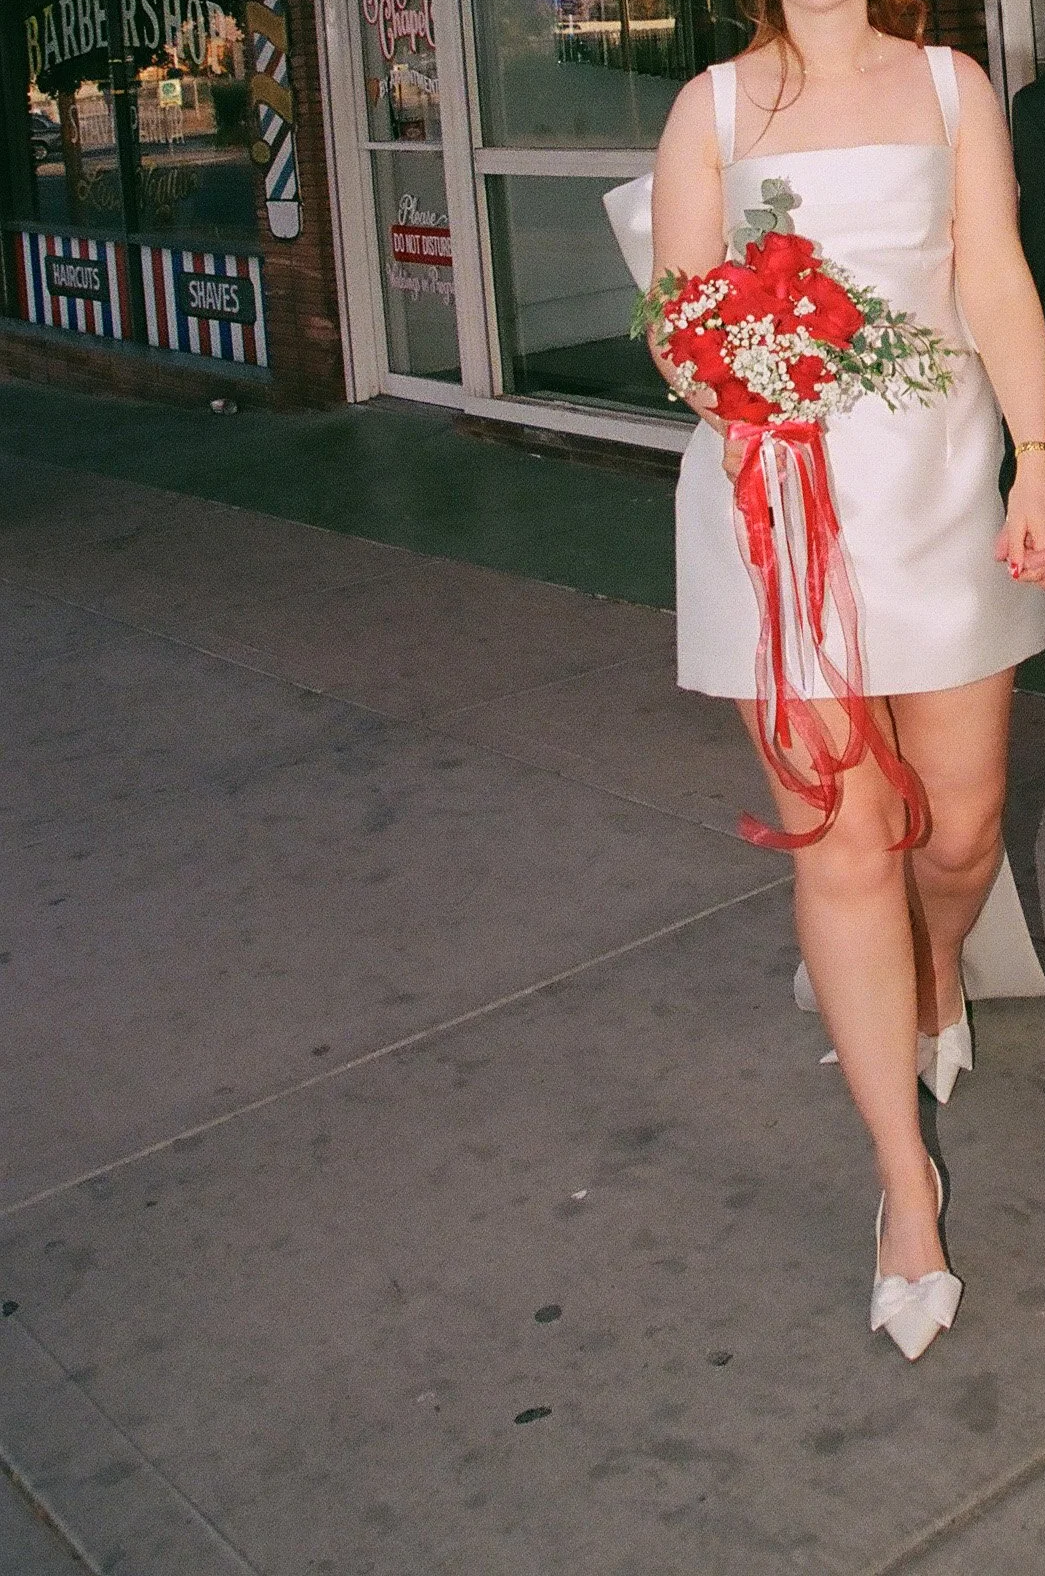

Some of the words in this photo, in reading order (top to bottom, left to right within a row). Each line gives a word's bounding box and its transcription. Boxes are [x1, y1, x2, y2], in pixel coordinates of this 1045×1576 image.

[398, 193, 449, 226] Please
[393, 232, 405, 253] DO
[405, 233, 421, 255] NOT
[53, 263, 100, 292] HAIRCUTS
[188, 280, 240, 314] SHAVES
